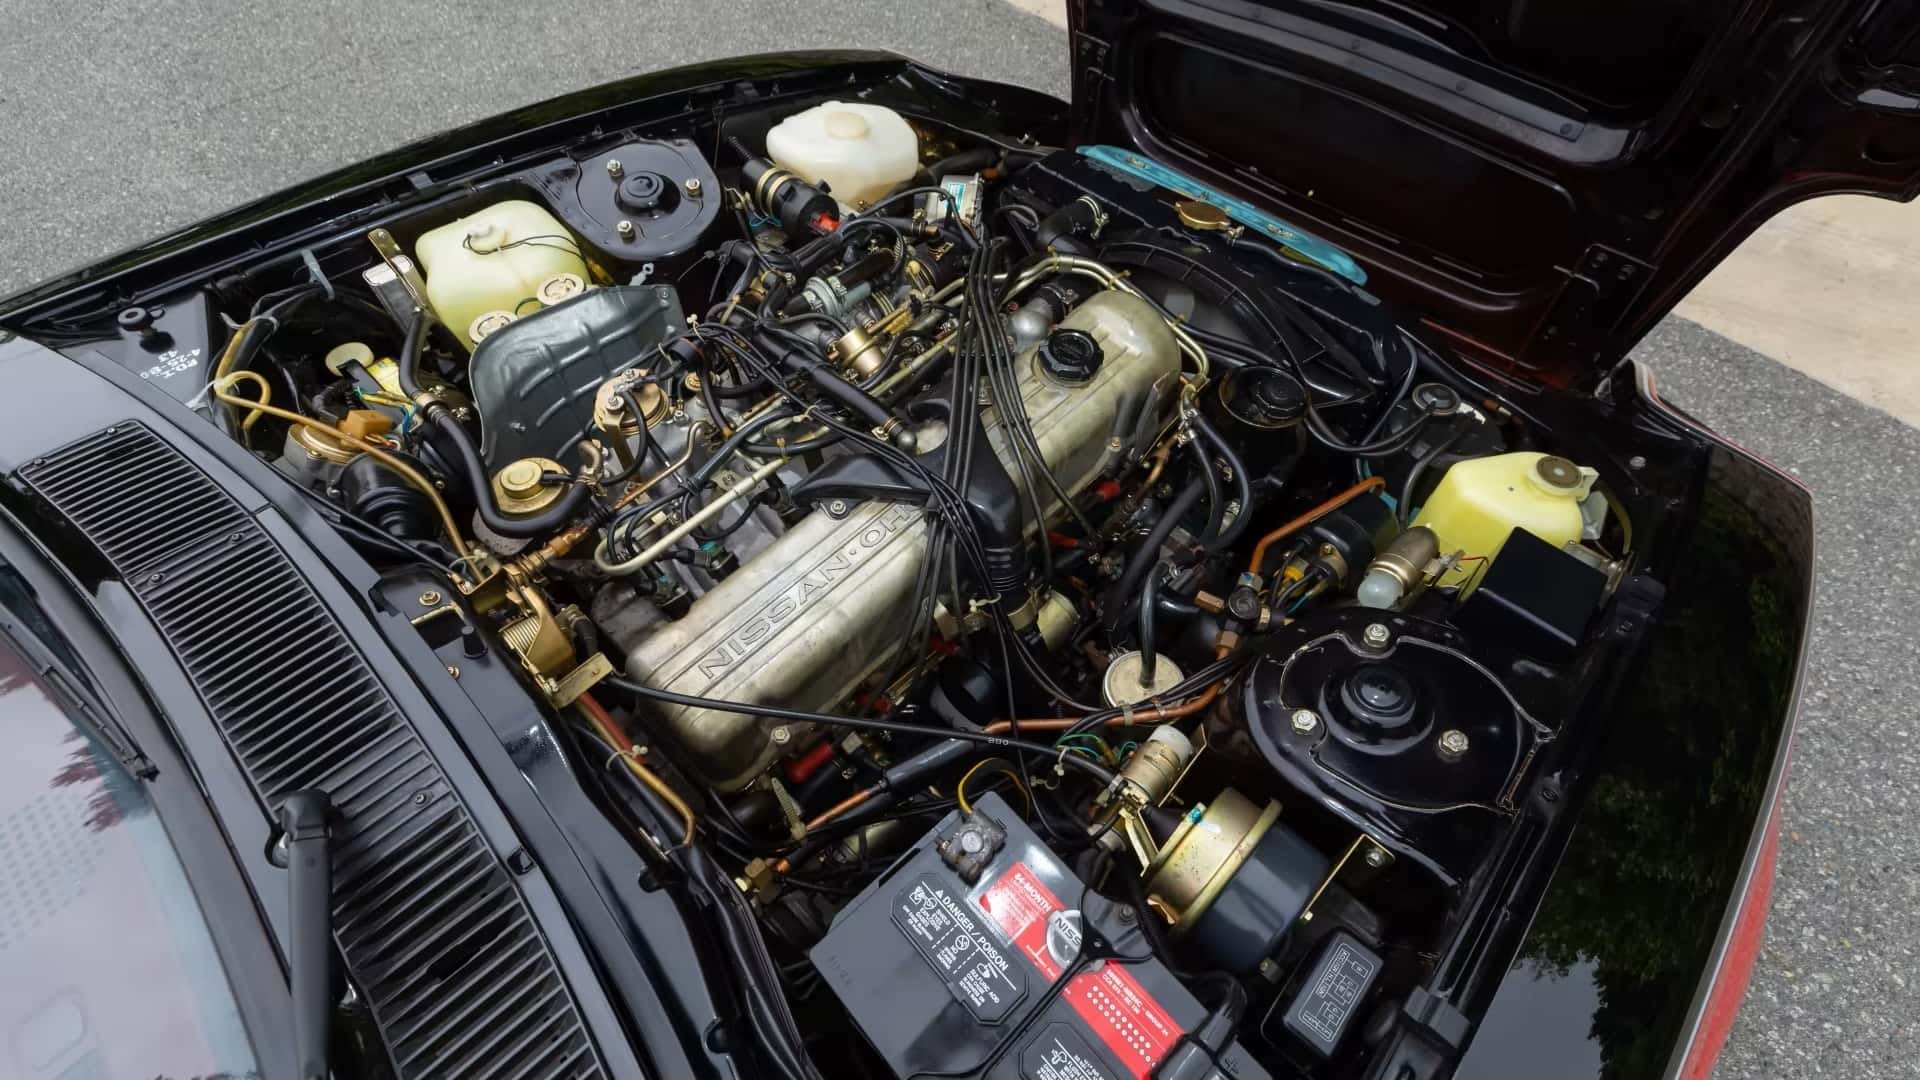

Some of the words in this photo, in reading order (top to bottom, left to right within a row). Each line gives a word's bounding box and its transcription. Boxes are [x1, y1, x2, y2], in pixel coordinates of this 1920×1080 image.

[697, 554, 852, 680] NISSAN
[941, 895, 975, 932] DANGER
[976, 935, 1009, 971] POISON
[949, 944, 959, 954] NO
[1054, 917, 1082, 946] NISS
